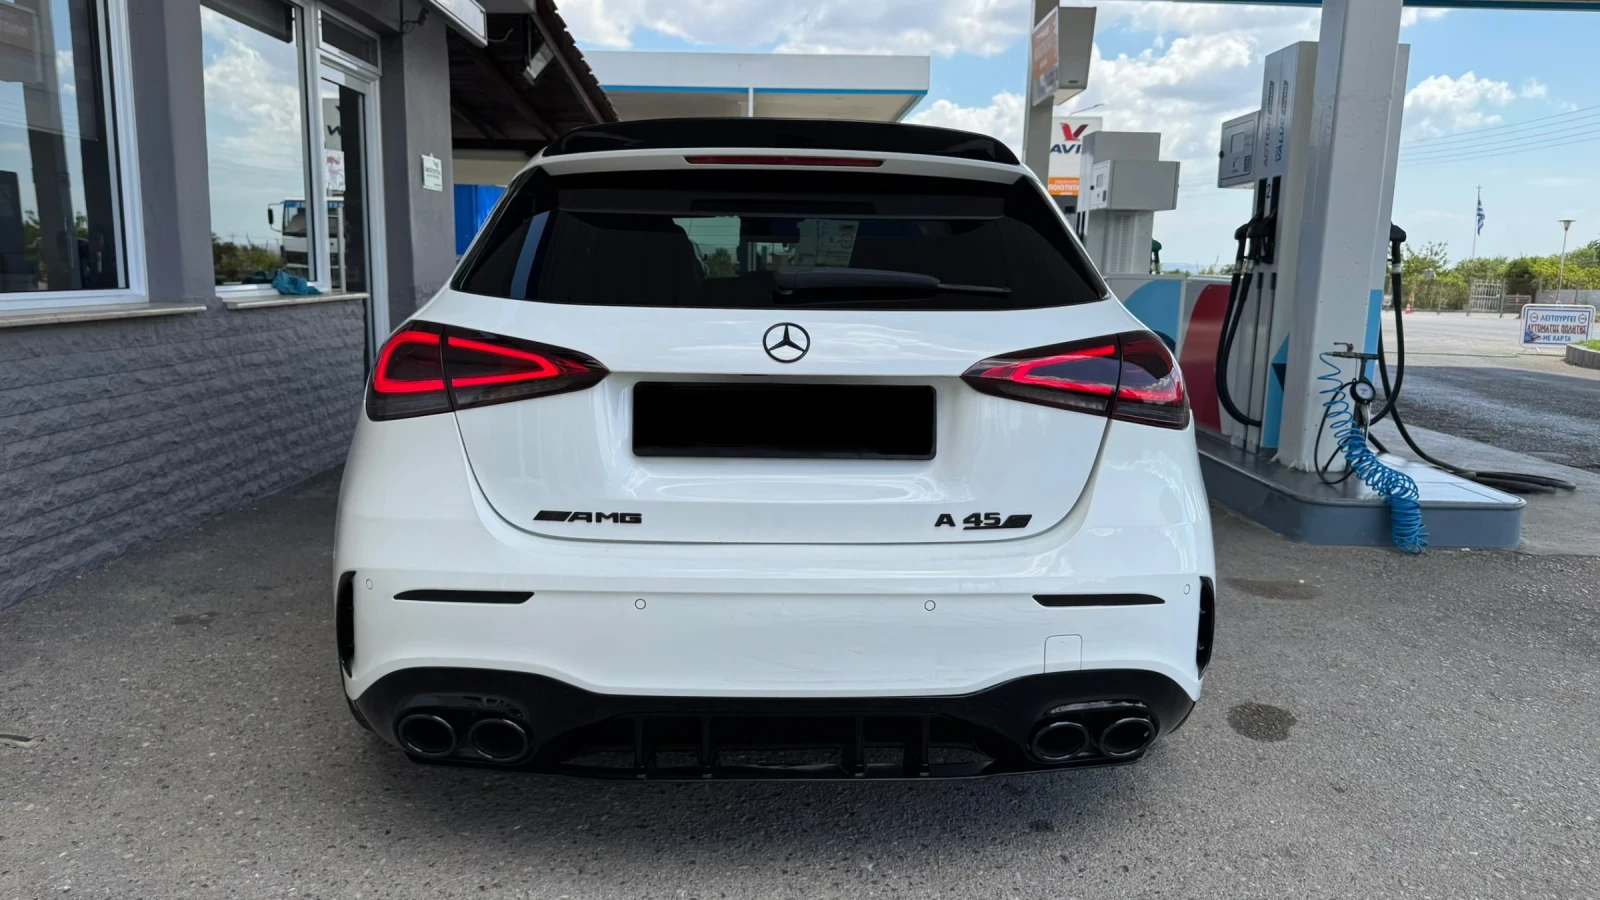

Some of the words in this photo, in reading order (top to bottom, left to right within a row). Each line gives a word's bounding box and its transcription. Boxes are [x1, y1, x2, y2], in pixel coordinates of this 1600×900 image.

[1266, 183, 1271, 199] 2
[567, 511, 642, 524] AMG
[934, 513, 956, 527] A
[963, 512, 1002, 526] 45
